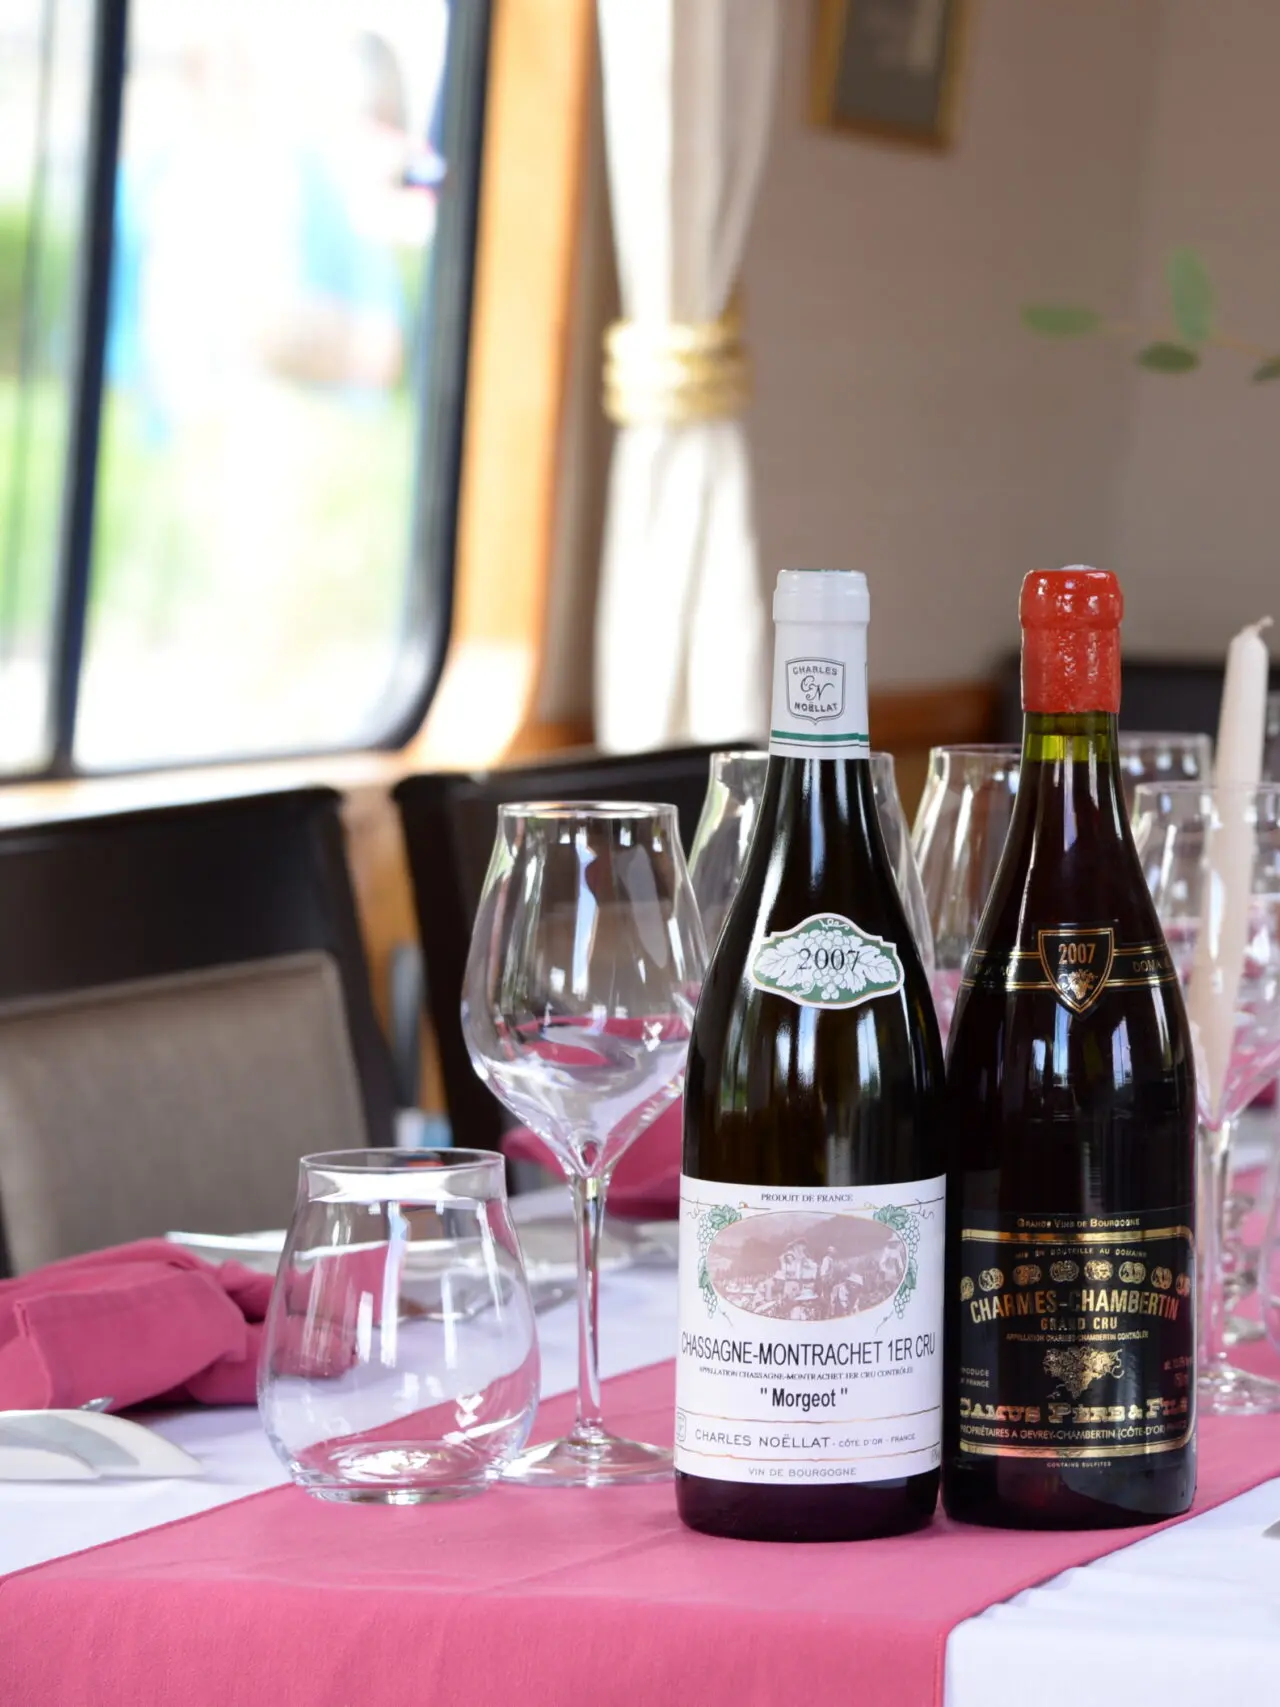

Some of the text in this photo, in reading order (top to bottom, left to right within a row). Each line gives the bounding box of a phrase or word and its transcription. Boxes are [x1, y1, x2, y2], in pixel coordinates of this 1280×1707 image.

[792, 665, 838, 676] CHARLES
[794, 701, 838, 713] NOËLLAT
[797, 947, 860, 972] 2007
[1058, 943, 1096, 965] 2007
[761, 1193, 854, 1203] PRODUIT DE FRANCE
[1099, 1247, 1111, 1255] AU
[1092, 1316, 1119, 1330] CRU
[681, 1331, 936, 1367] CHASSAGNE-MONTRACHET 1ER CRU
[845, 1371, 859, 1380] 1ER
[861, 1370, 876, 1379] CRU
[961, 1366, 990, 1377] RODUCE
[1128, 1404, 1143, 1420] &
[695, 1428, 752, 1447] CHARLES
[759, 1433, 830, 1448] NOËLLAT
[838, 1438, 860, 1448] CÔTE
[890, 1433, 916, 1443] FRANCE
[1020, 1429, 1116, 1440] GEVREY-CHAMBERTIN
[1047, 1460, 1112, 1468] CONTAINS SULFITES
[748, 1467, 857, 1478] VIN DE BOURGOGNE
